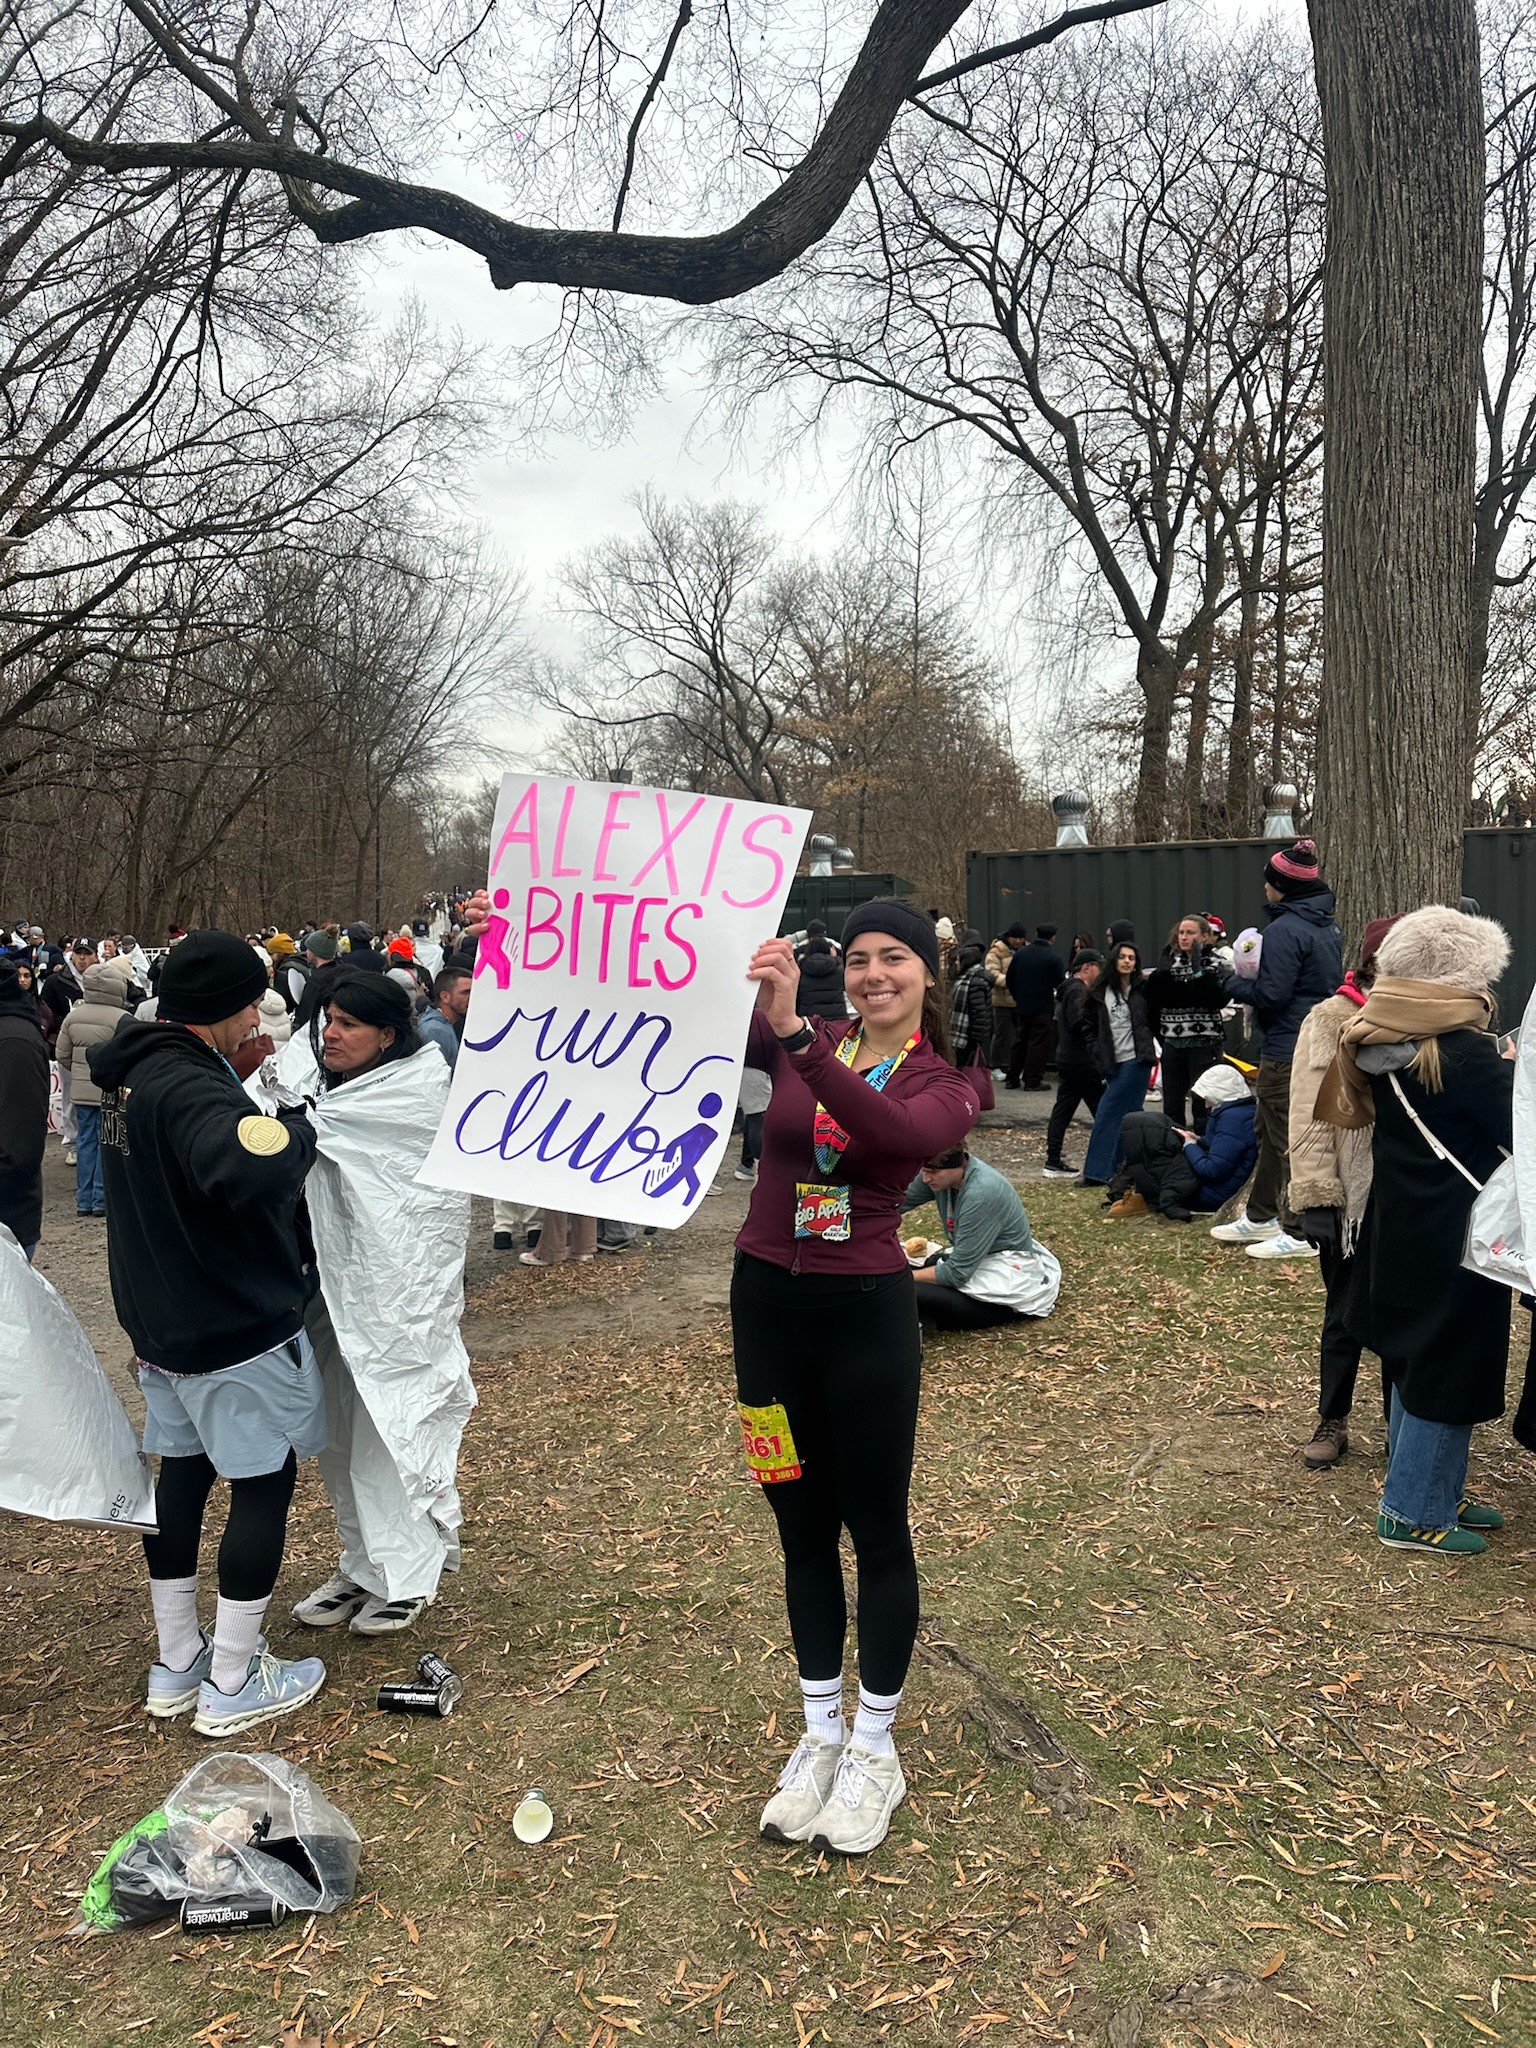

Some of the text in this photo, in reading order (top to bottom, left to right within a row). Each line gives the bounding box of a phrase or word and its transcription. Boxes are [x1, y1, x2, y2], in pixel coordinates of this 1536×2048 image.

[489, 782, 793, 909] ALEXIS
[522, 886, 703, 991] BITES
[463, 1006, 735, 1095] run
[455, 1070, 667, 1184] club
[795, 1199, 851, 1227] BIG APPLE
[393, 1692, 439, 1702] smartwater
[186, 1910, 249, 1925] smartwater
